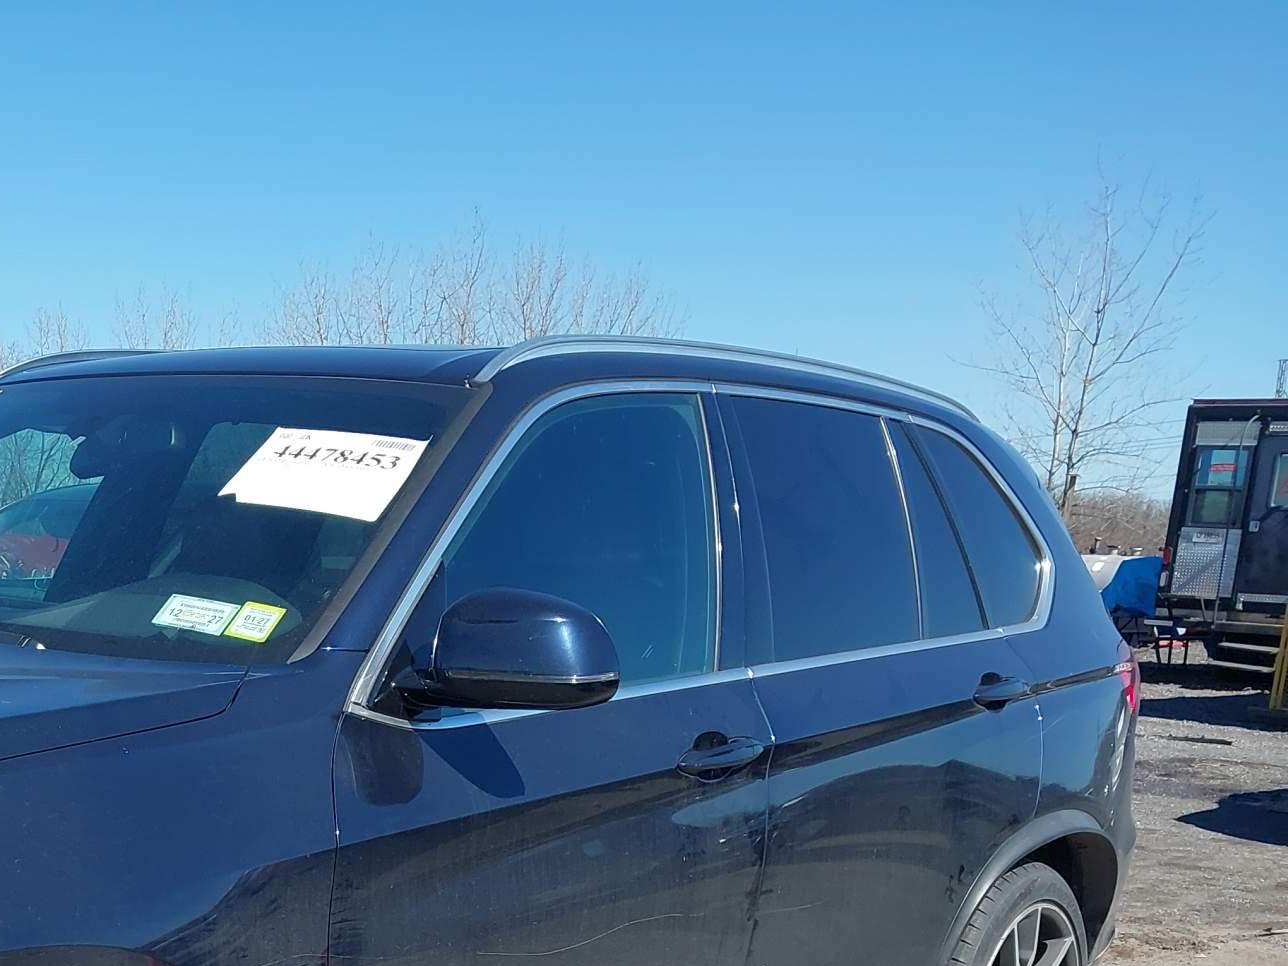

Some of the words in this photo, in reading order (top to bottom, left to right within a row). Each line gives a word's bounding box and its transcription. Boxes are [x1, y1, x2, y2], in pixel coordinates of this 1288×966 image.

[274, 445, 401, 470] 44478453
[169, 607, 183, 618] 12
[207, 615, 224, 625] 27
